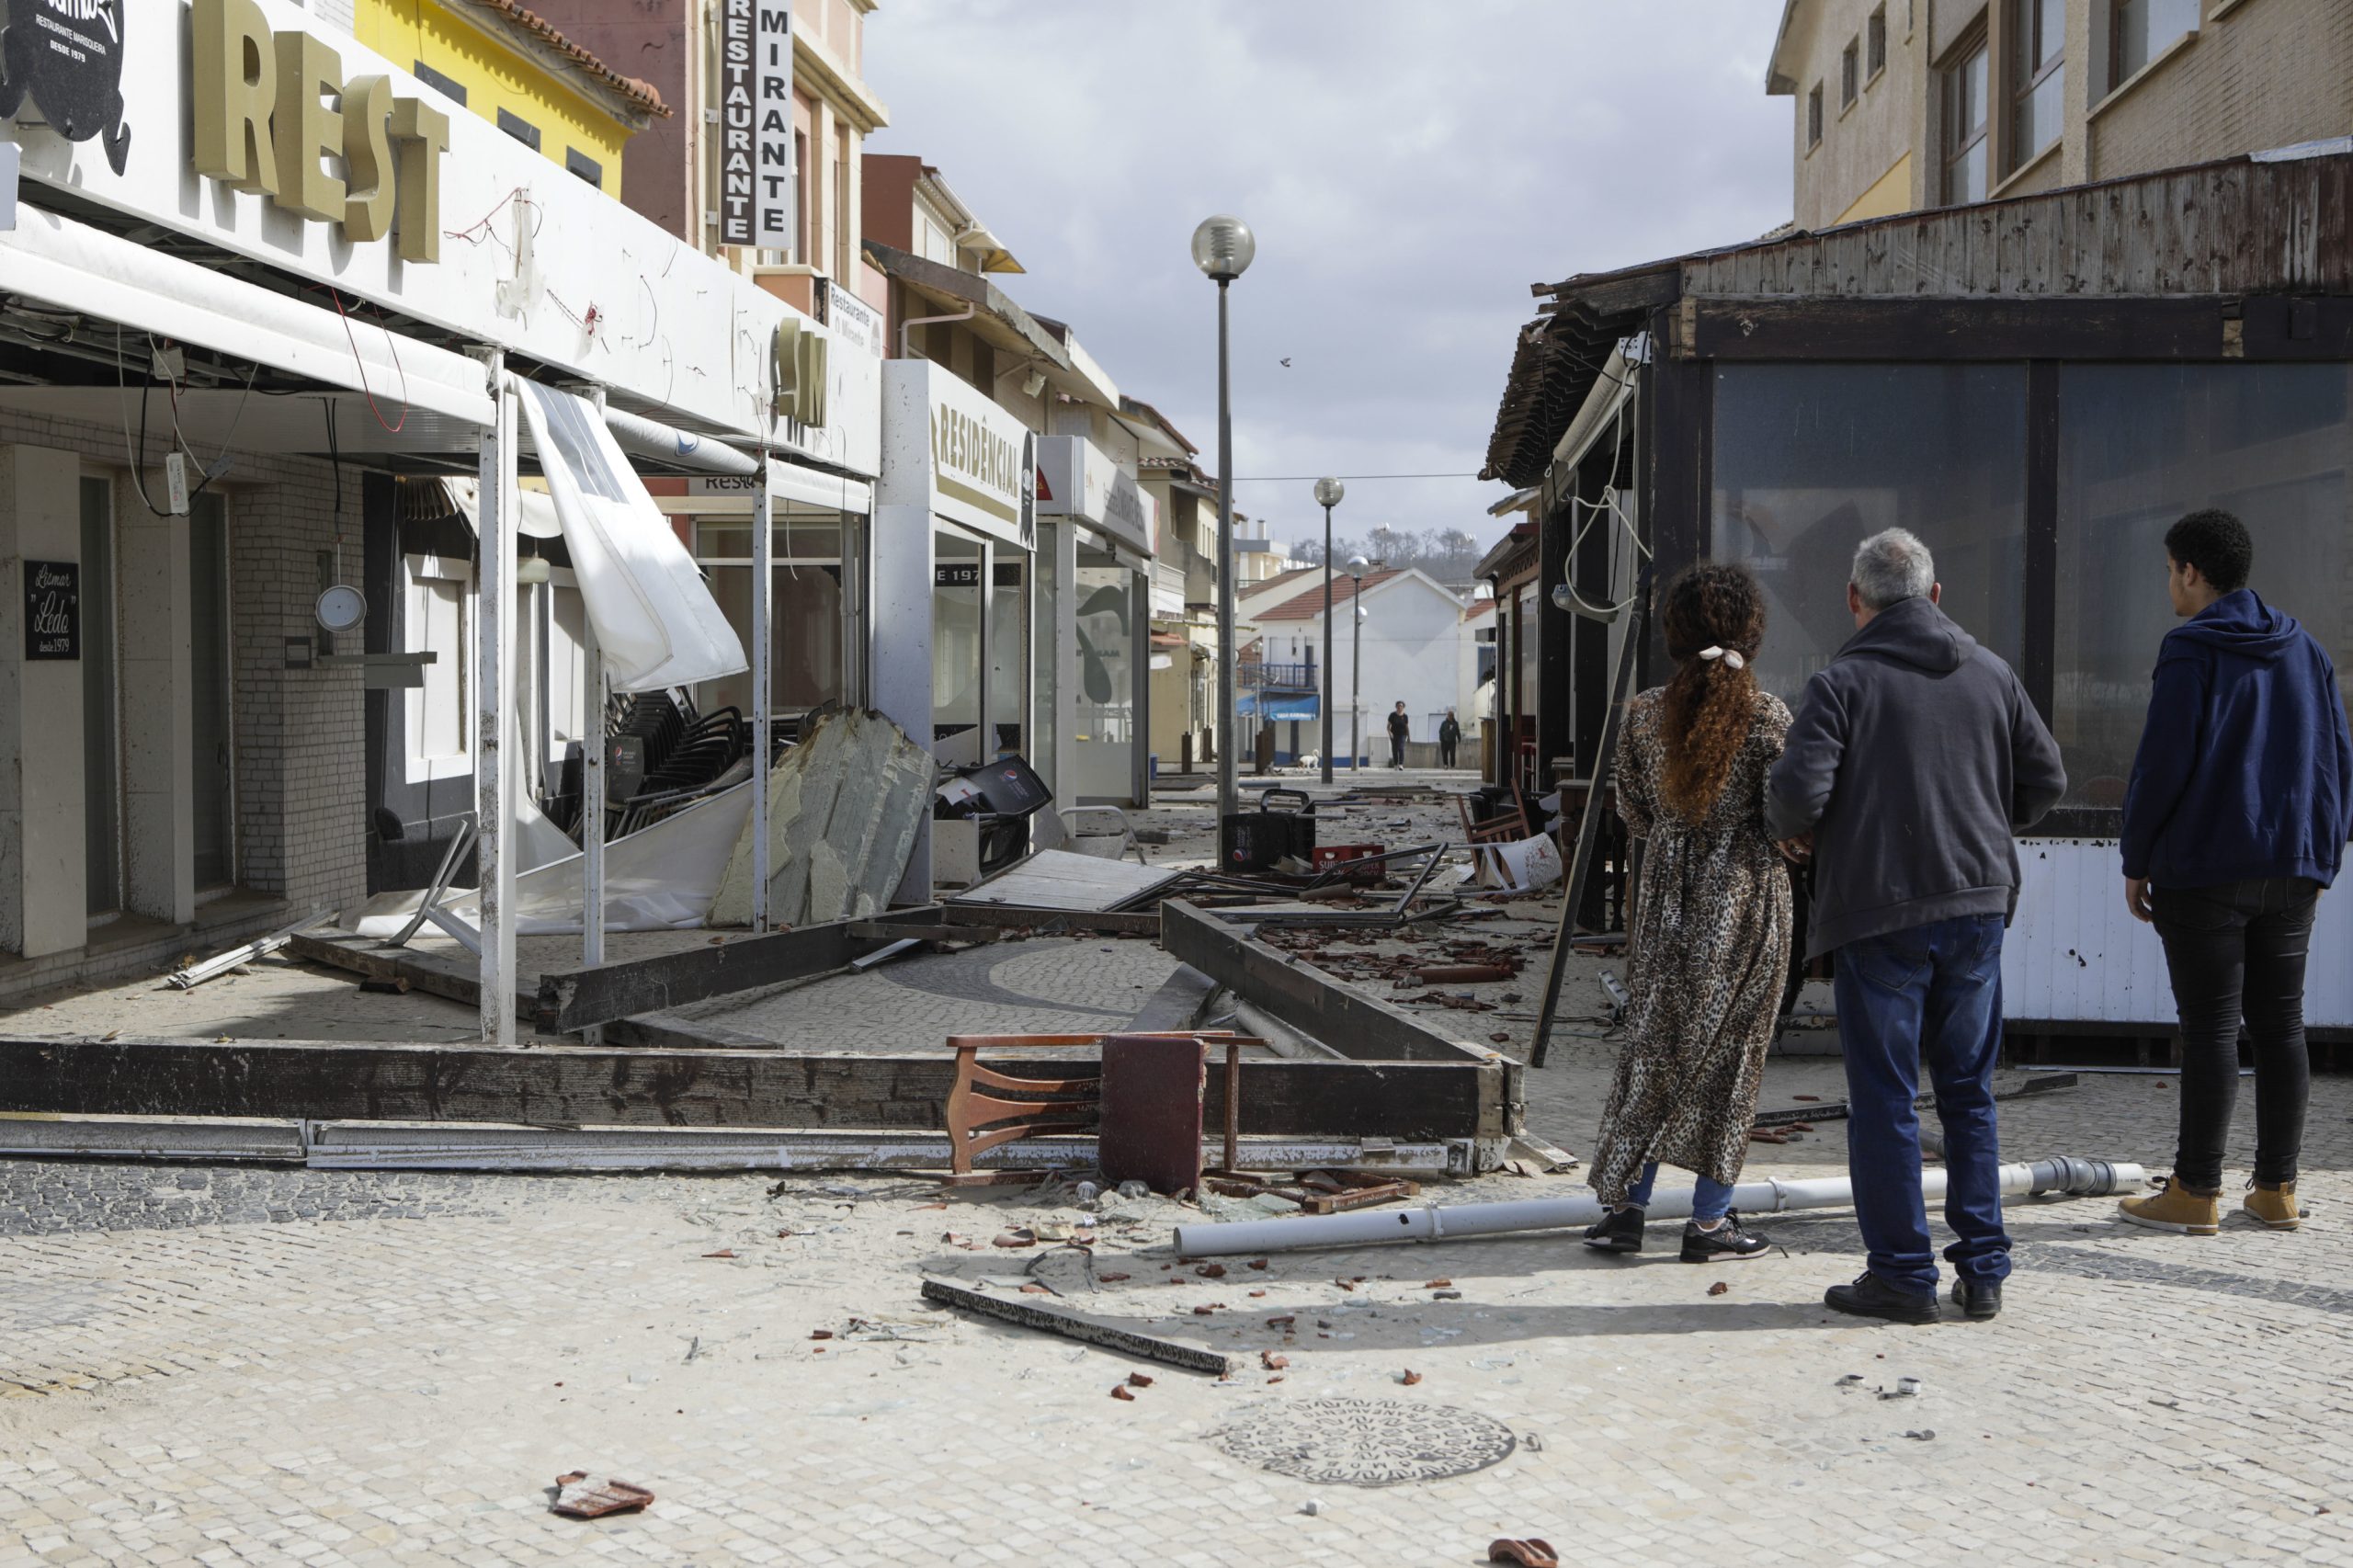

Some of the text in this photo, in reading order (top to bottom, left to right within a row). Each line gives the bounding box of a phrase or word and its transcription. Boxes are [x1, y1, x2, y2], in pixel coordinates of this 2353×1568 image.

[35, 14, 107, 55] RESTAURANTE MARISQUEIRA
[50, 40, 86, 62] DESDE 1979
[192, 0, 450, 265] REST
[727, 0, 751, 239] RESTAURANTE
[761, 9, 787, 233] MIRANTE
[831, 286, 870, 327] Restaurante
[940, 403, 1018, 499] RESIDÊNCIAL
[54, 638, 70, 653] 1979
